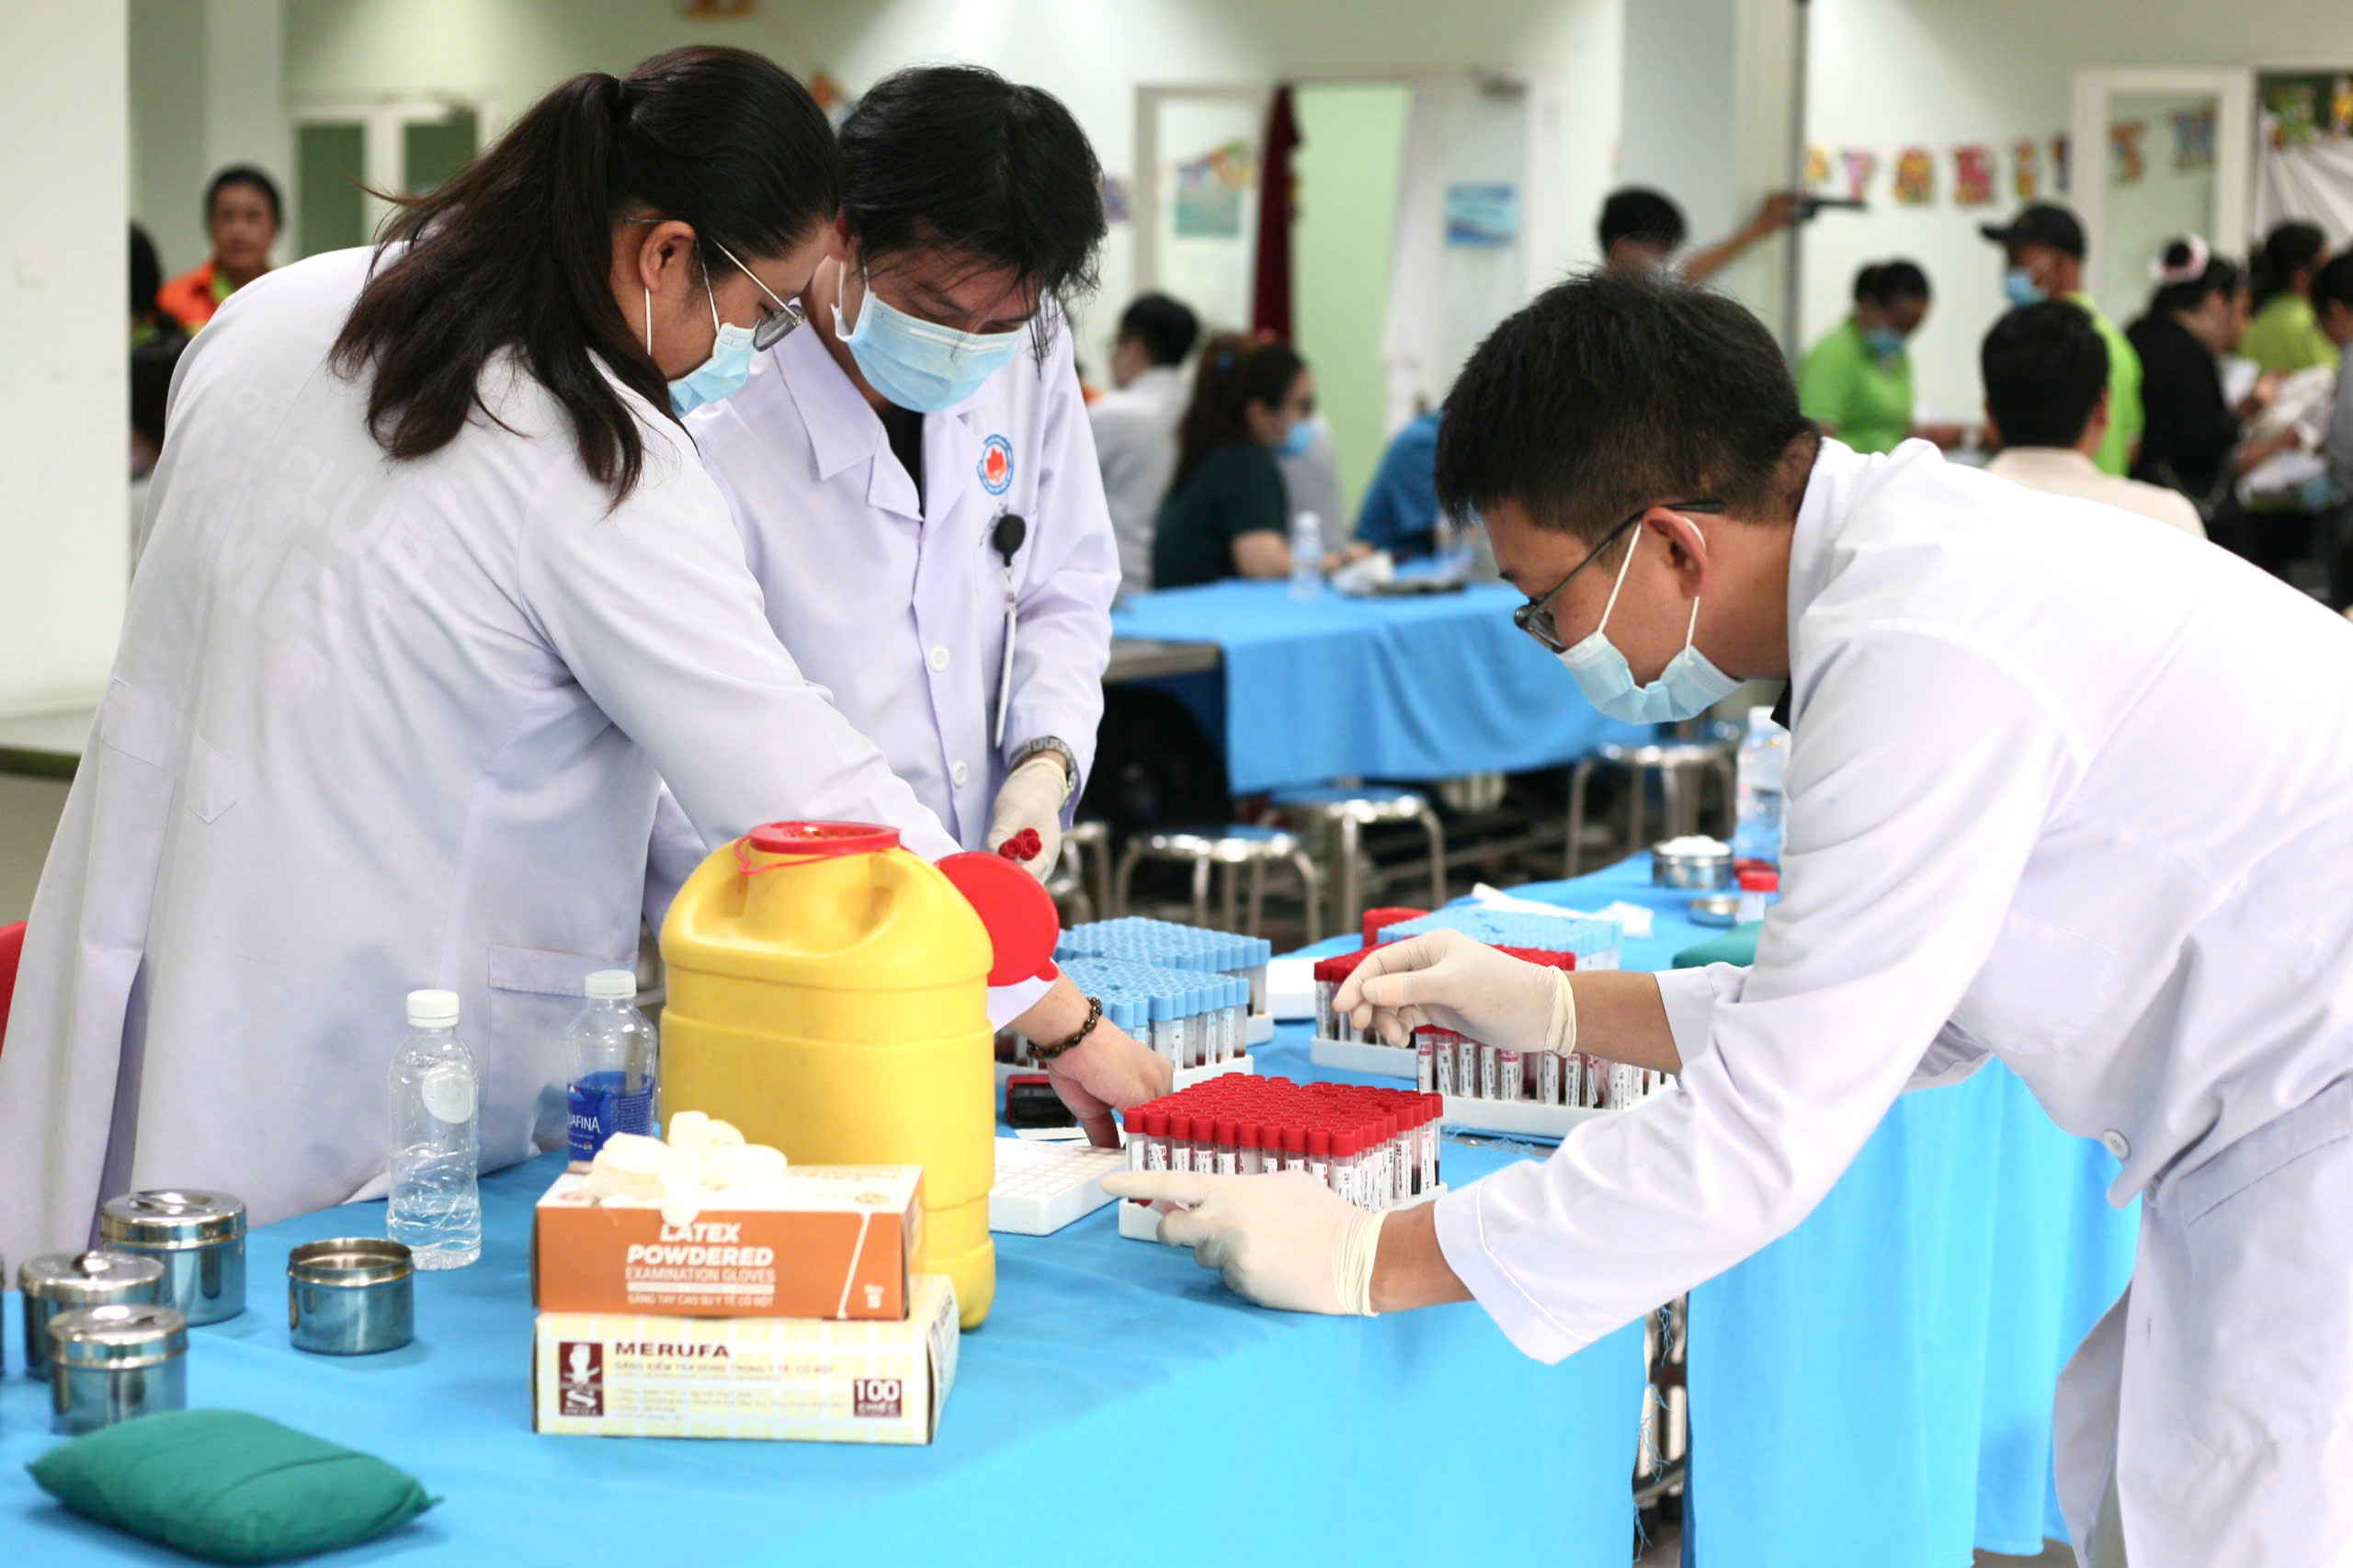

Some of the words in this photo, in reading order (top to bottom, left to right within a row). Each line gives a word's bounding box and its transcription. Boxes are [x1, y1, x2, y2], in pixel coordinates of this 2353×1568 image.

[567, 1111, 601, 1134] UAFINA
[660, 1221, 742, 1243] LATEX
[626, 1244, 775, 1267] POWDERED
[625, 1267, 721, 1281] EXAMINATION
[722, 1267, 776, 1283] GLOVES
[615, 1342, 730, 1358] MERUFA
[854, 1379, 901, 1402] 100
